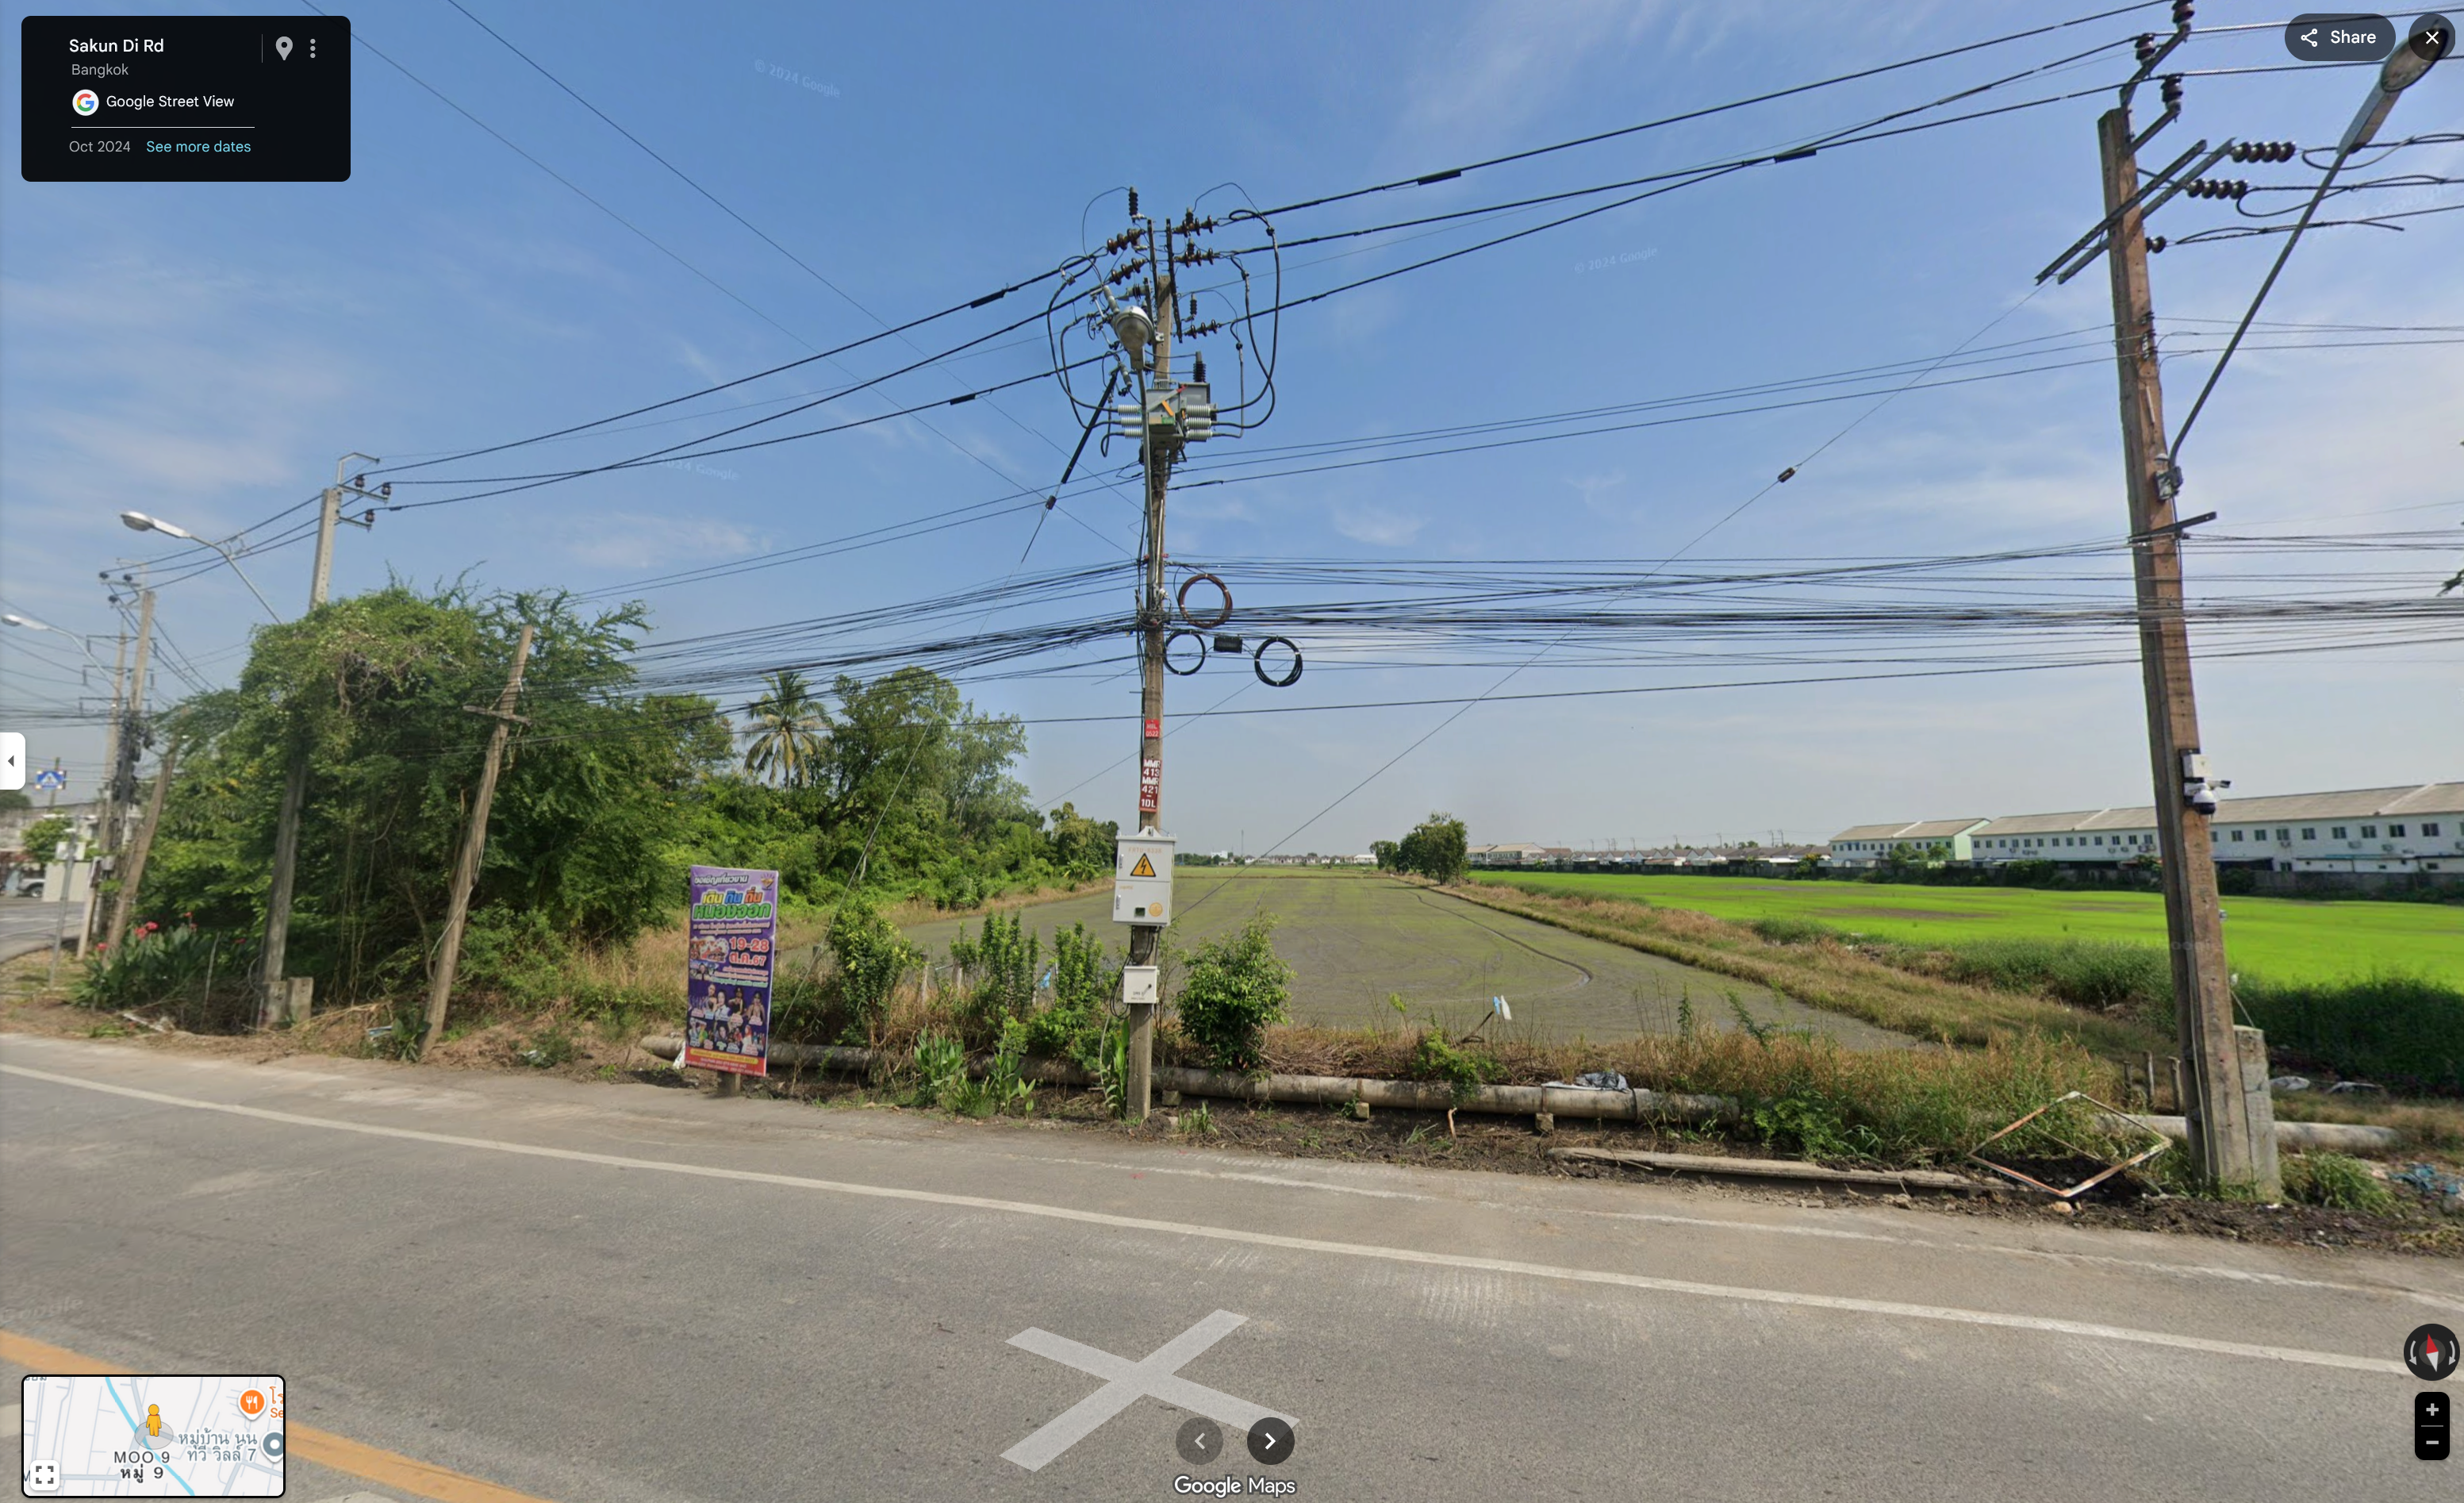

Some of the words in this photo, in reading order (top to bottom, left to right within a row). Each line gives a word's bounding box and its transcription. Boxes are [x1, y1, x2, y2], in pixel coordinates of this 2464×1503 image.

[1144, 759, 1161, 768] MMR
[1143, 767, 1160, 777] 413
[1142, 776, 1159, 785] MMR
[1142, 785, 1158, 794] 421
[1141, 798, 1157, 808] 1DL
[693, 902, 773, 920] หนองจอก
[729, 936, 770, 952] 19-28
[729, 951, 767, 967] ต.ค.67
